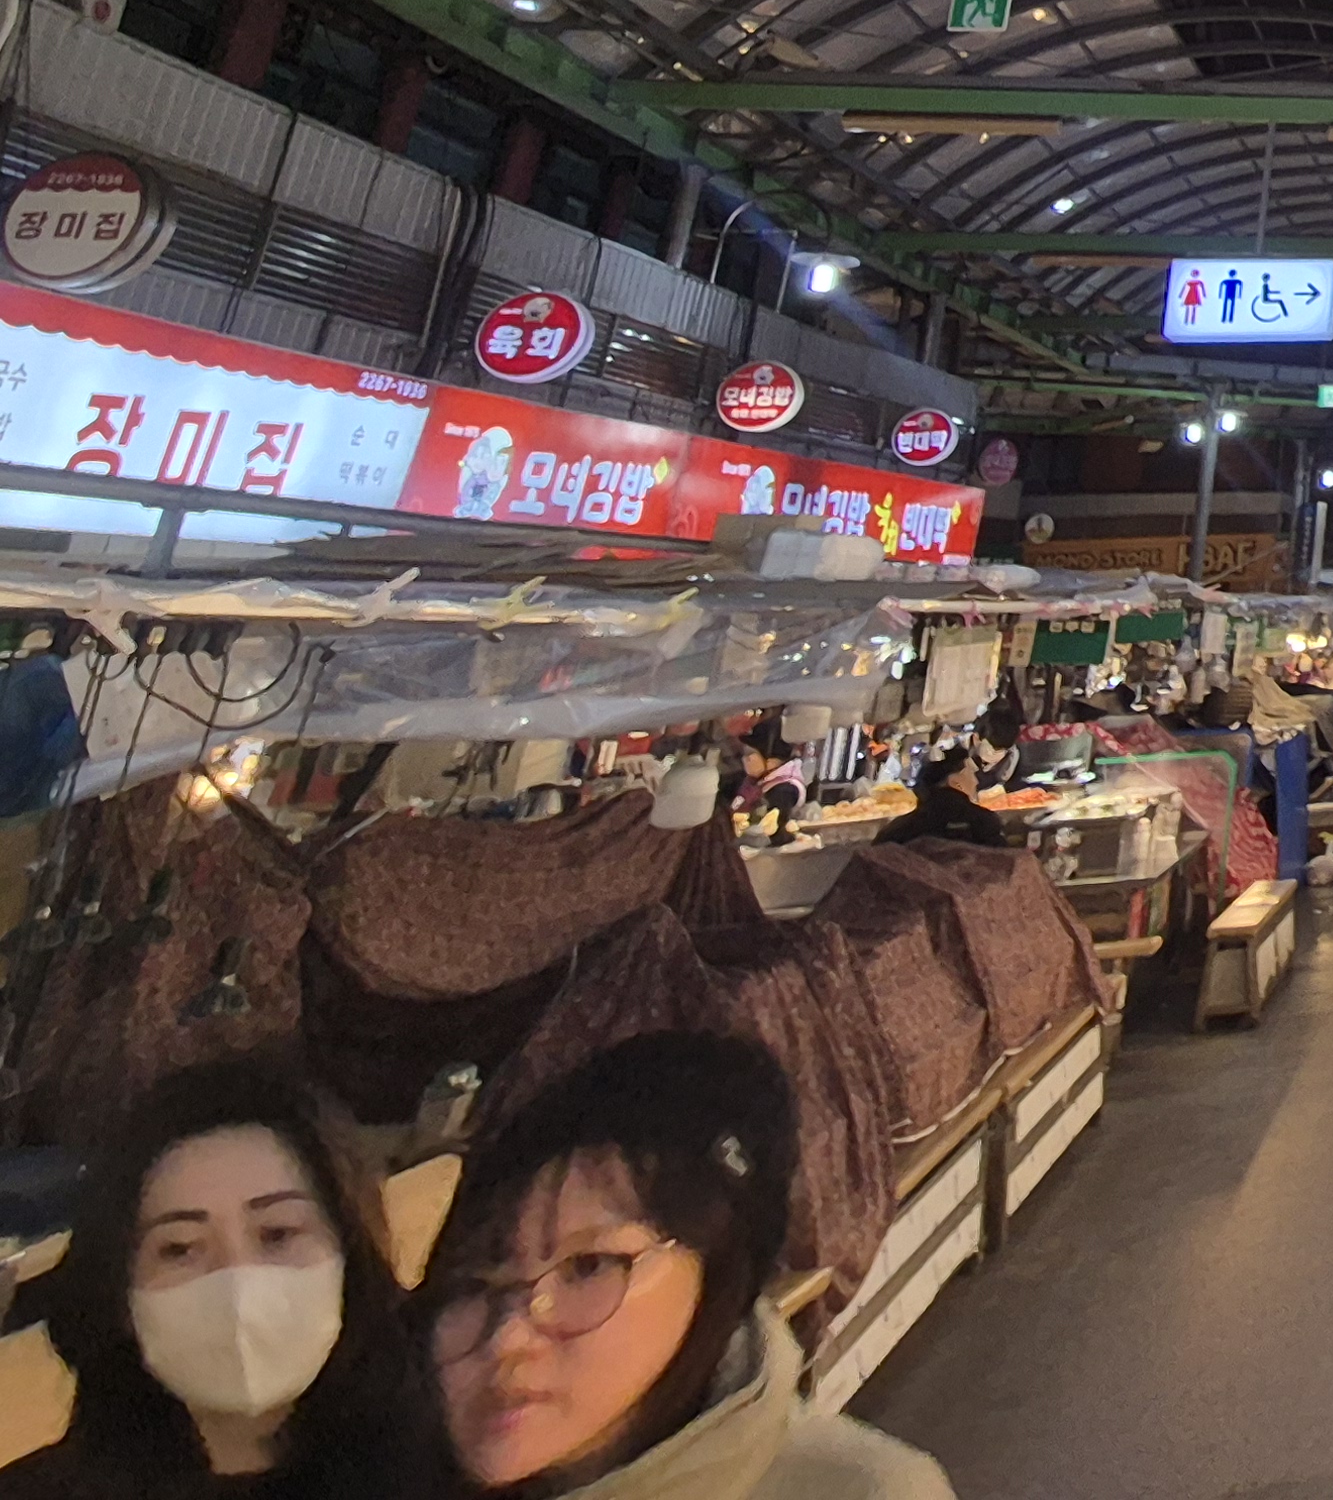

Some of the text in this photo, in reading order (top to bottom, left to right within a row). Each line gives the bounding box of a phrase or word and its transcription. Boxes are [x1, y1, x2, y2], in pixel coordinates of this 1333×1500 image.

[15, 210, 126, 241] 장미집
[487, 324, 567, 360] 육회
[65, 393, 305, 498] 장미집
[509, 451, 656, 525] 모녀김밥
